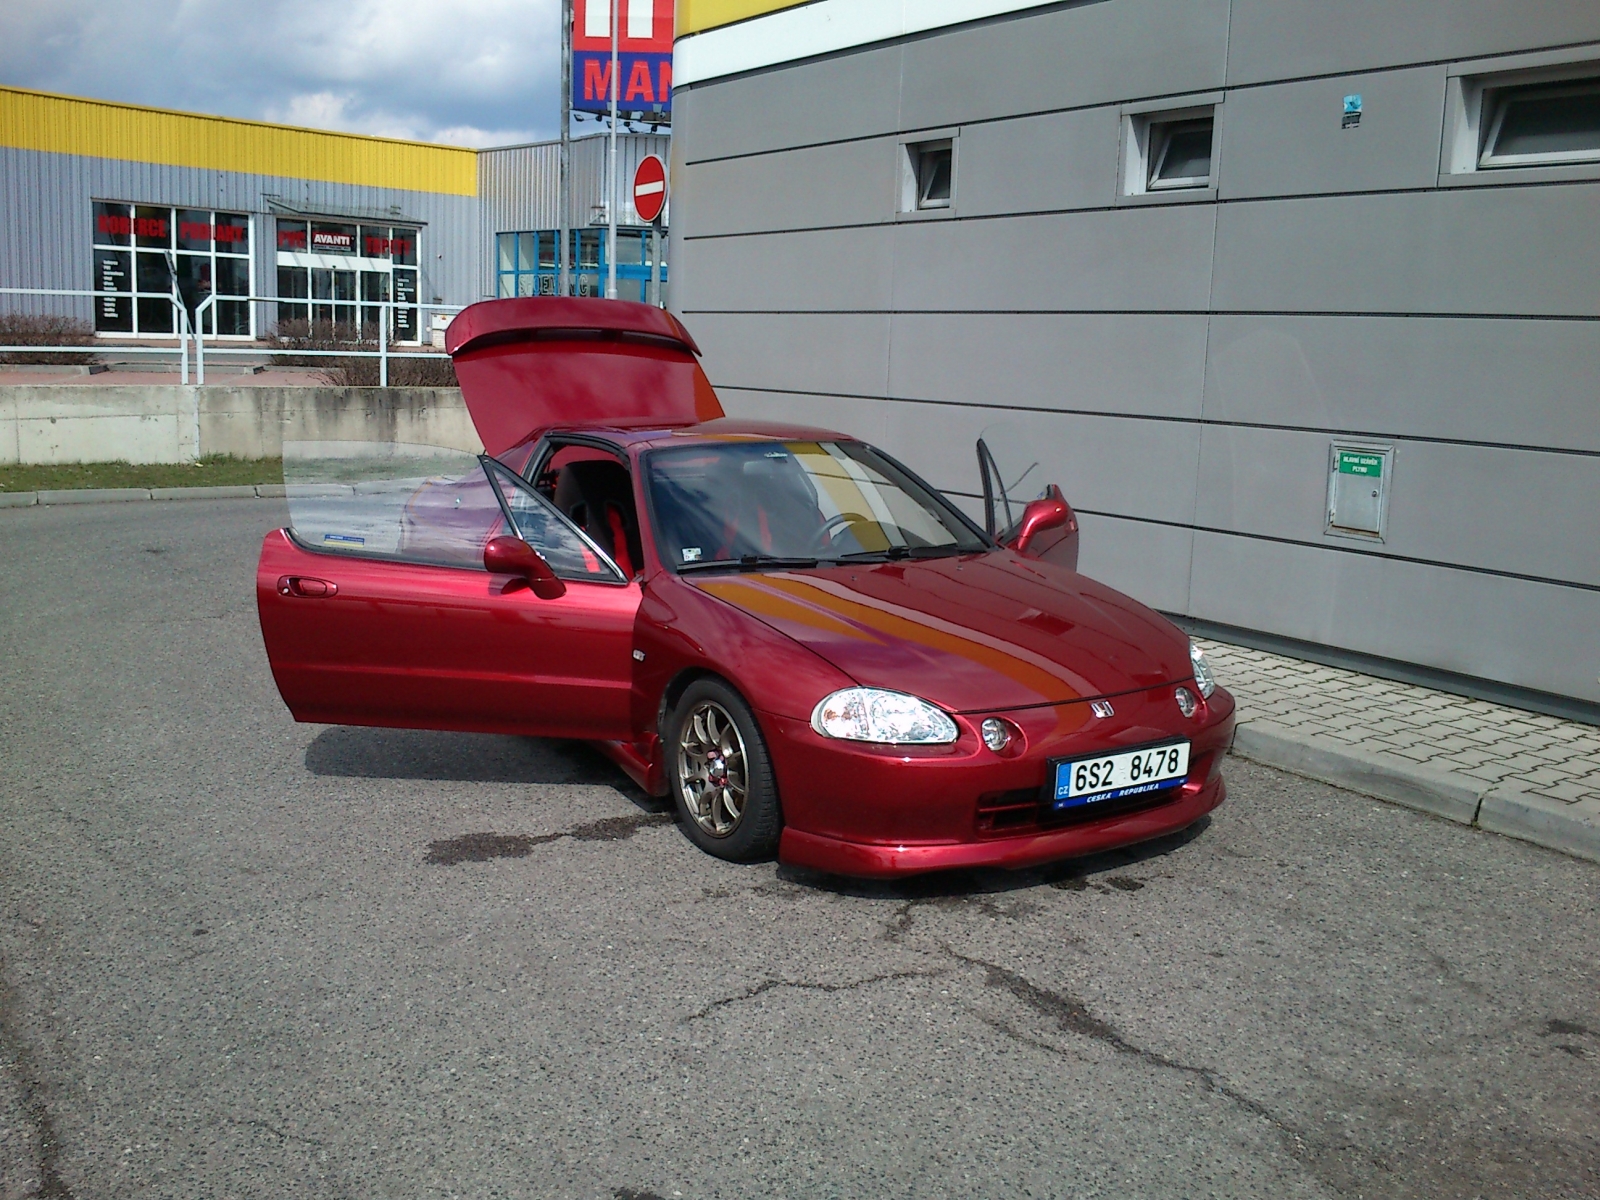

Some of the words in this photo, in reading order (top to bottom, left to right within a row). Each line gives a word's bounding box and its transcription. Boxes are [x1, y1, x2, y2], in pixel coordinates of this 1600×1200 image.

[98, 215, 166, 238] KOBERCE
[180, 221, 243, 242] PODLAHY
[314, 233, 350, 245] AVANTI
[1075, 760, 1114, 791] 6S2
[1130, 748, 1179, 781] 8478
[1058, 786, 1068, 795] CZ
[1119, 783, 1160, 797] REPUBLIKA
